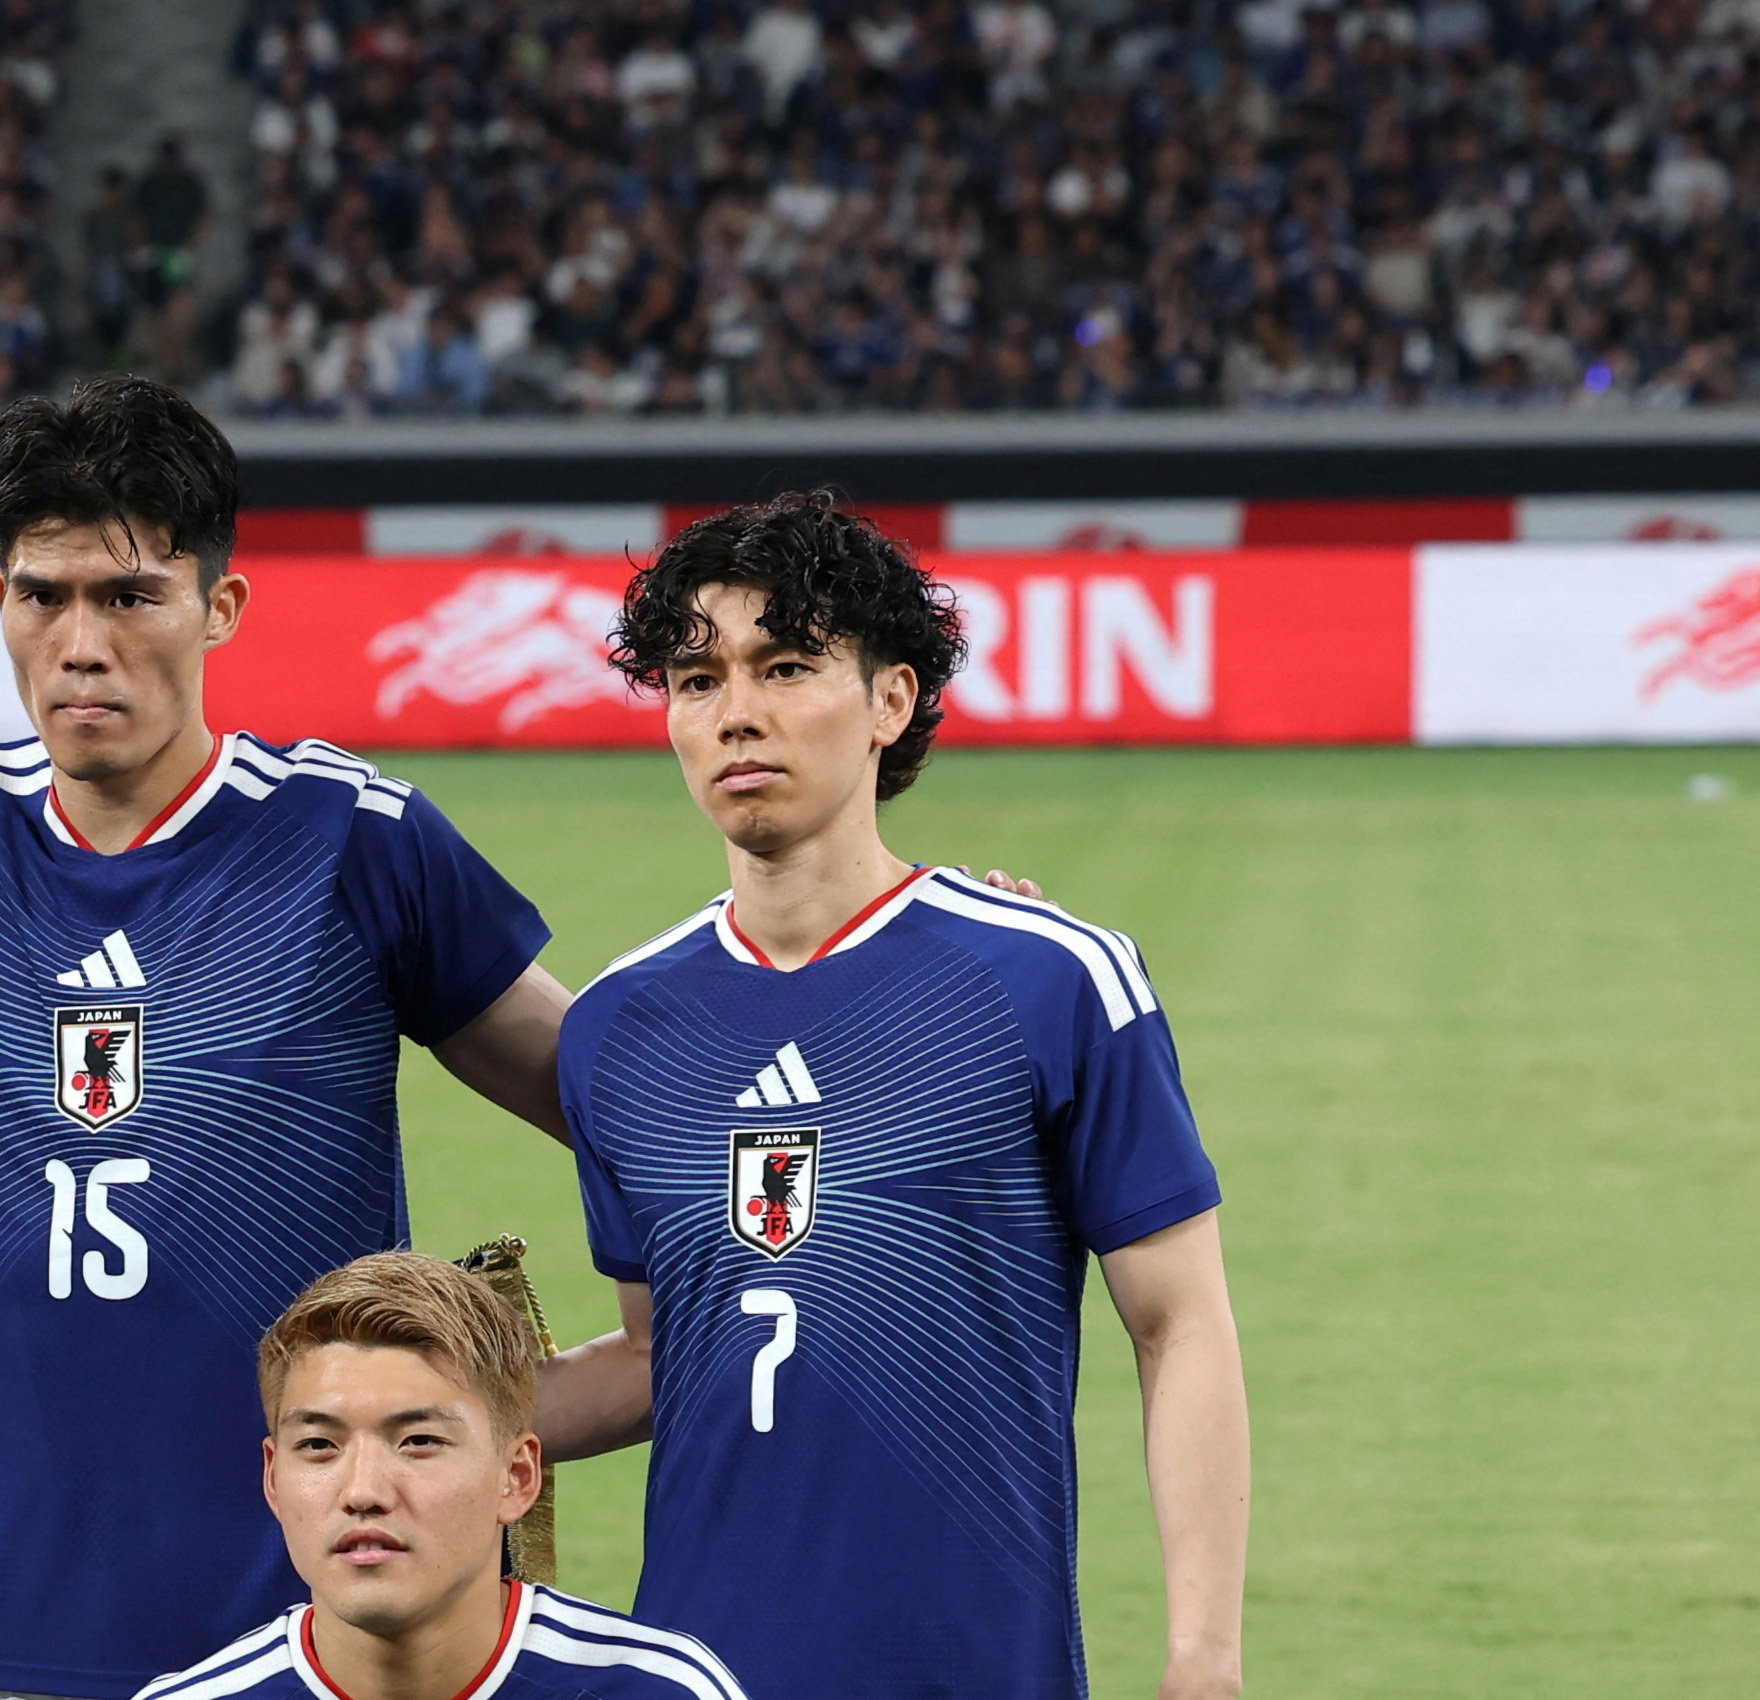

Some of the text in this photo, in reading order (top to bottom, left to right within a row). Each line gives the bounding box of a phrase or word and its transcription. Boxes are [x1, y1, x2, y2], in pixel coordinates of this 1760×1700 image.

[77, 1010, 122, 1023] JAPAN
[78, 1089, 117, 1110] JFA
[755, 1133, 800, 1146] JAPAN
[45, 1158, 151, 1299] 15
[756, 1215, 794, 1235] JFA
[740, 1289, 797, 1432] 7
